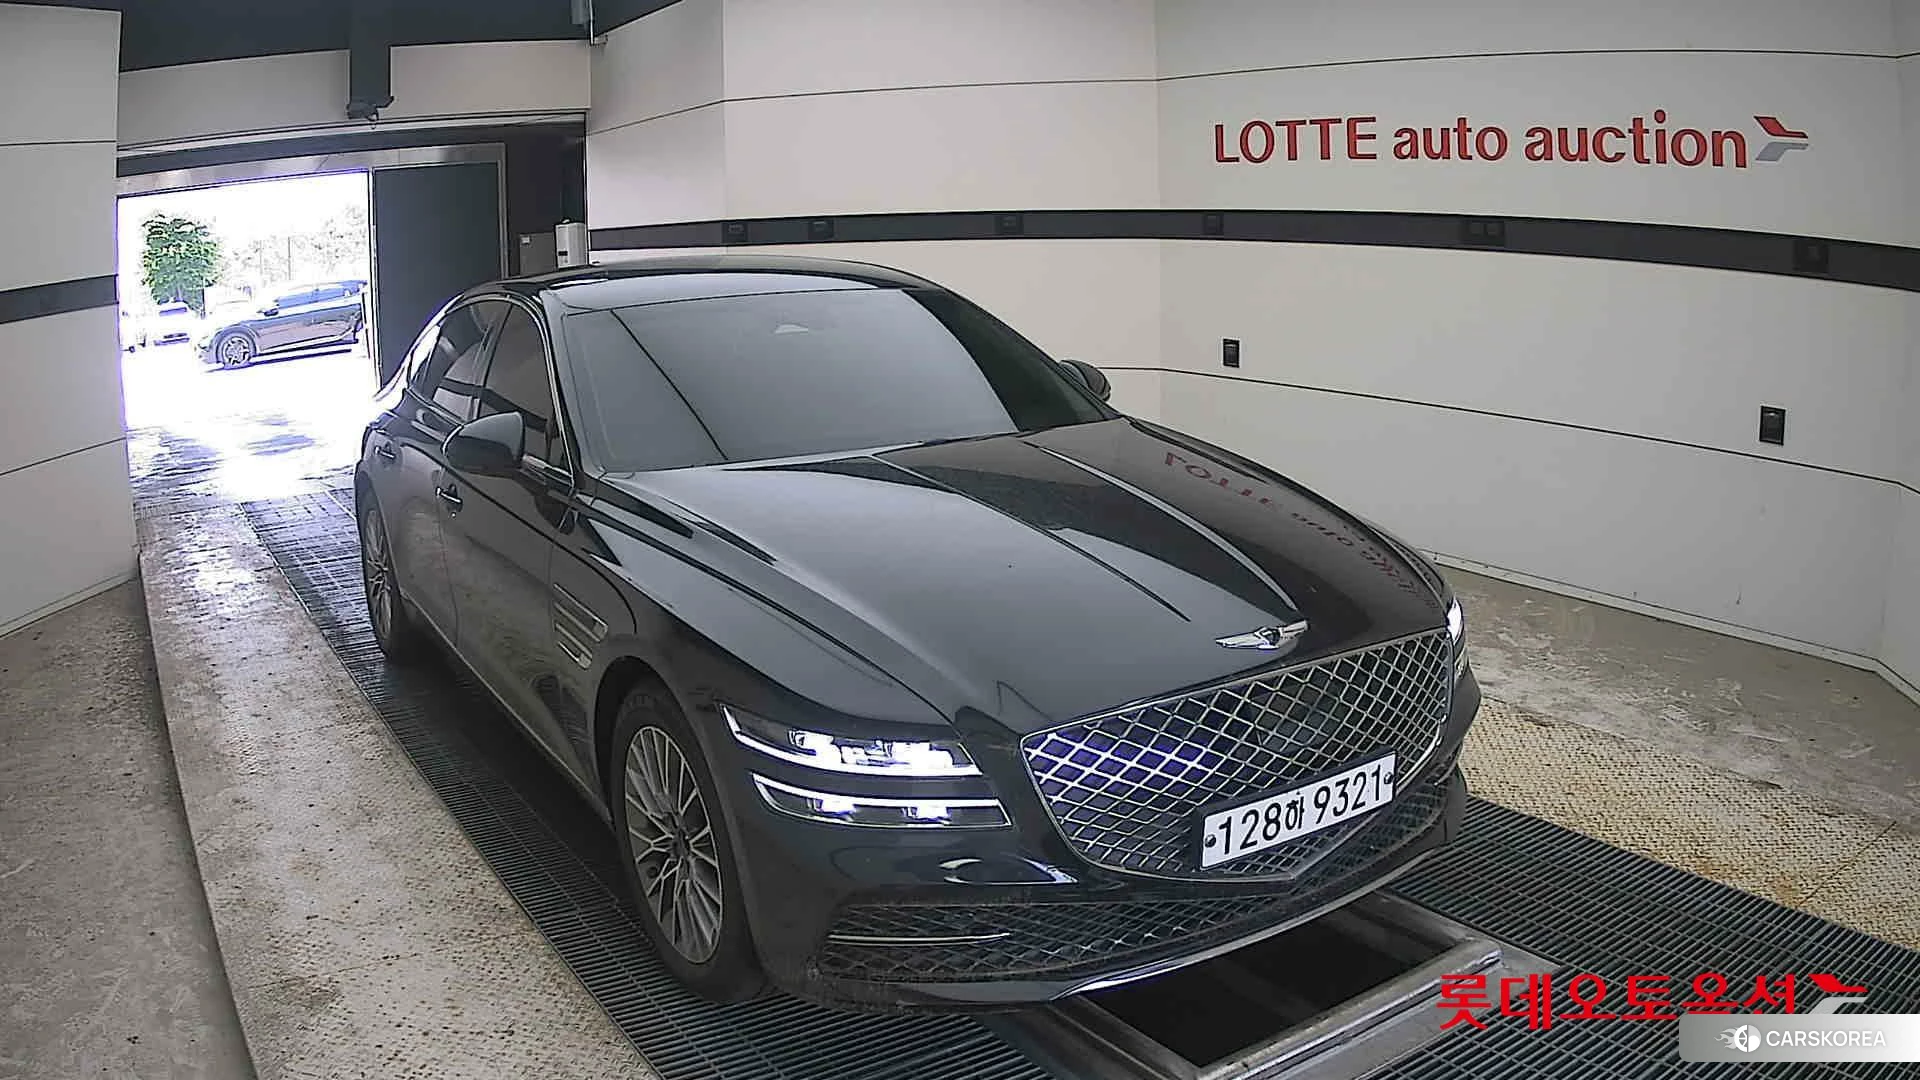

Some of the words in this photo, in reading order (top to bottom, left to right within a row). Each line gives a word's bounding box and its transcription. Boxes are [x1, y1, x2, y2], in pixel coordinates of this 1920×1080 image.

[1214, 116, 1377, 164] LOTTE
[1393, 117, 1508, 162] auto
[1524, 109, 1748, 168] auction
[1218, 796, 1304, 855] 128하
[1314, 764, 1382, 825] 9321
